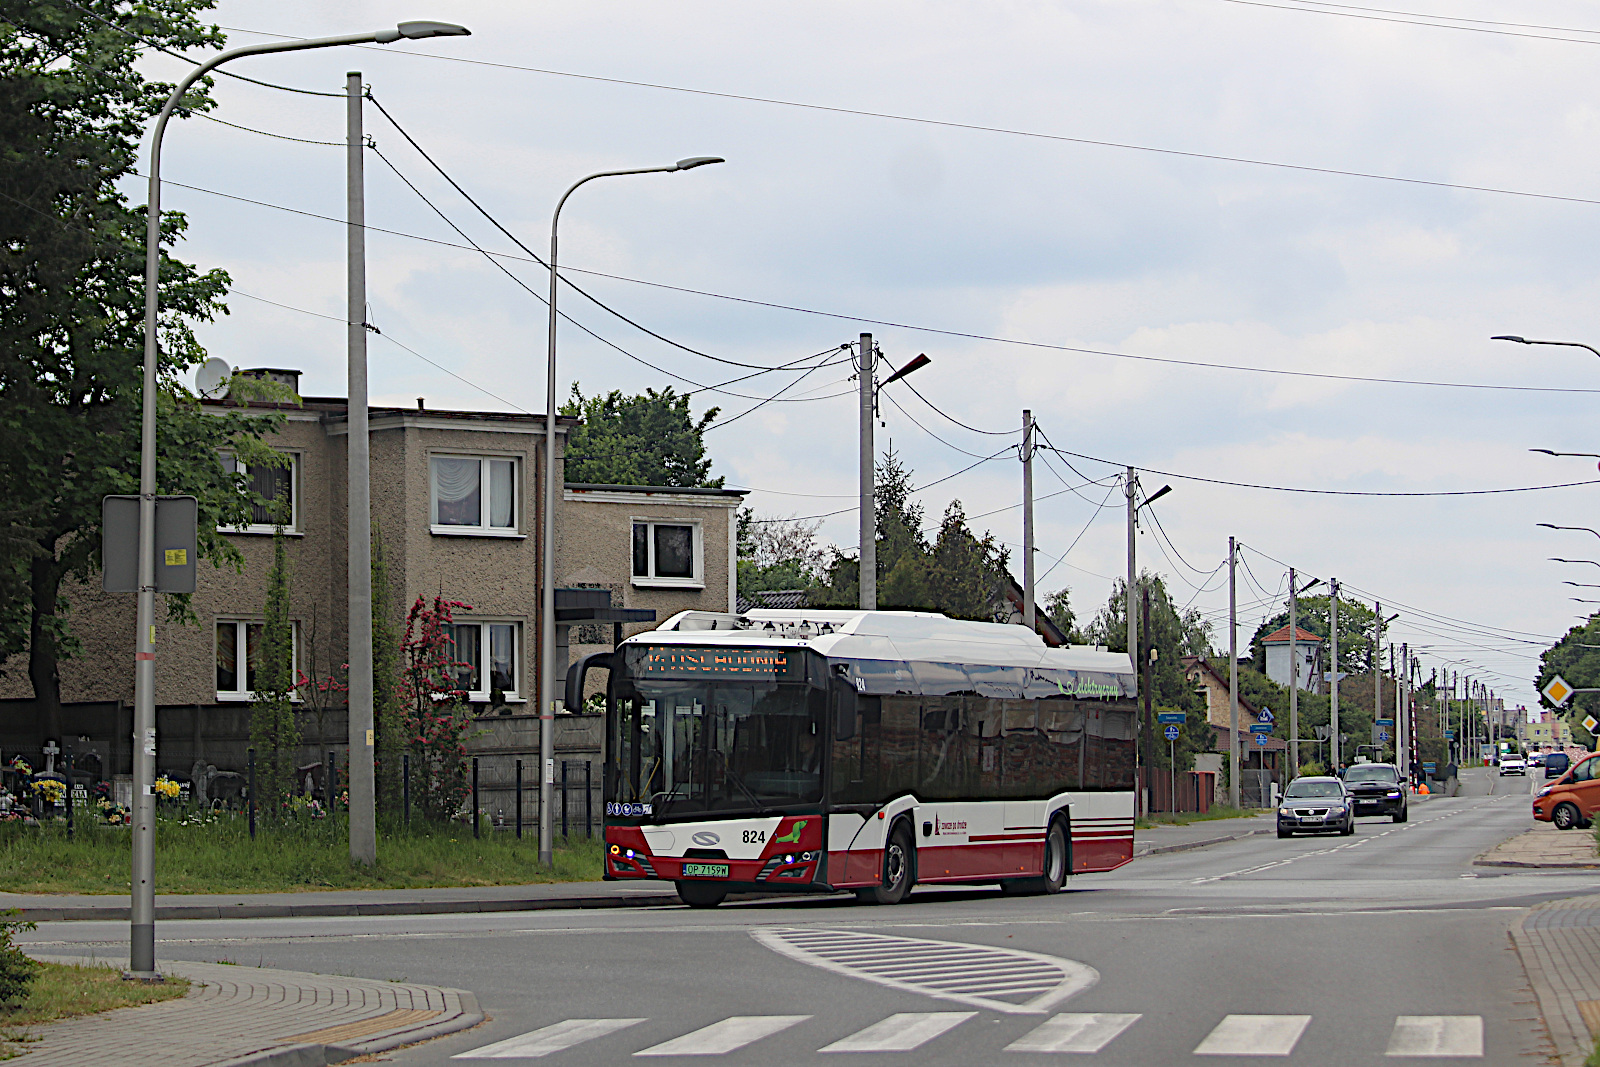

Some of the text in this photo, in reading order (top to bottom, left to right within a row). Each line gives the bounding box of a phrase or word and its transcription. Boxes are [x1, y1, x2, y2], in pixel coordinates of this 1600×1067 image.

[742, 830, 765, 844] 824
[687, 865, 727, 875] OP 7159W
